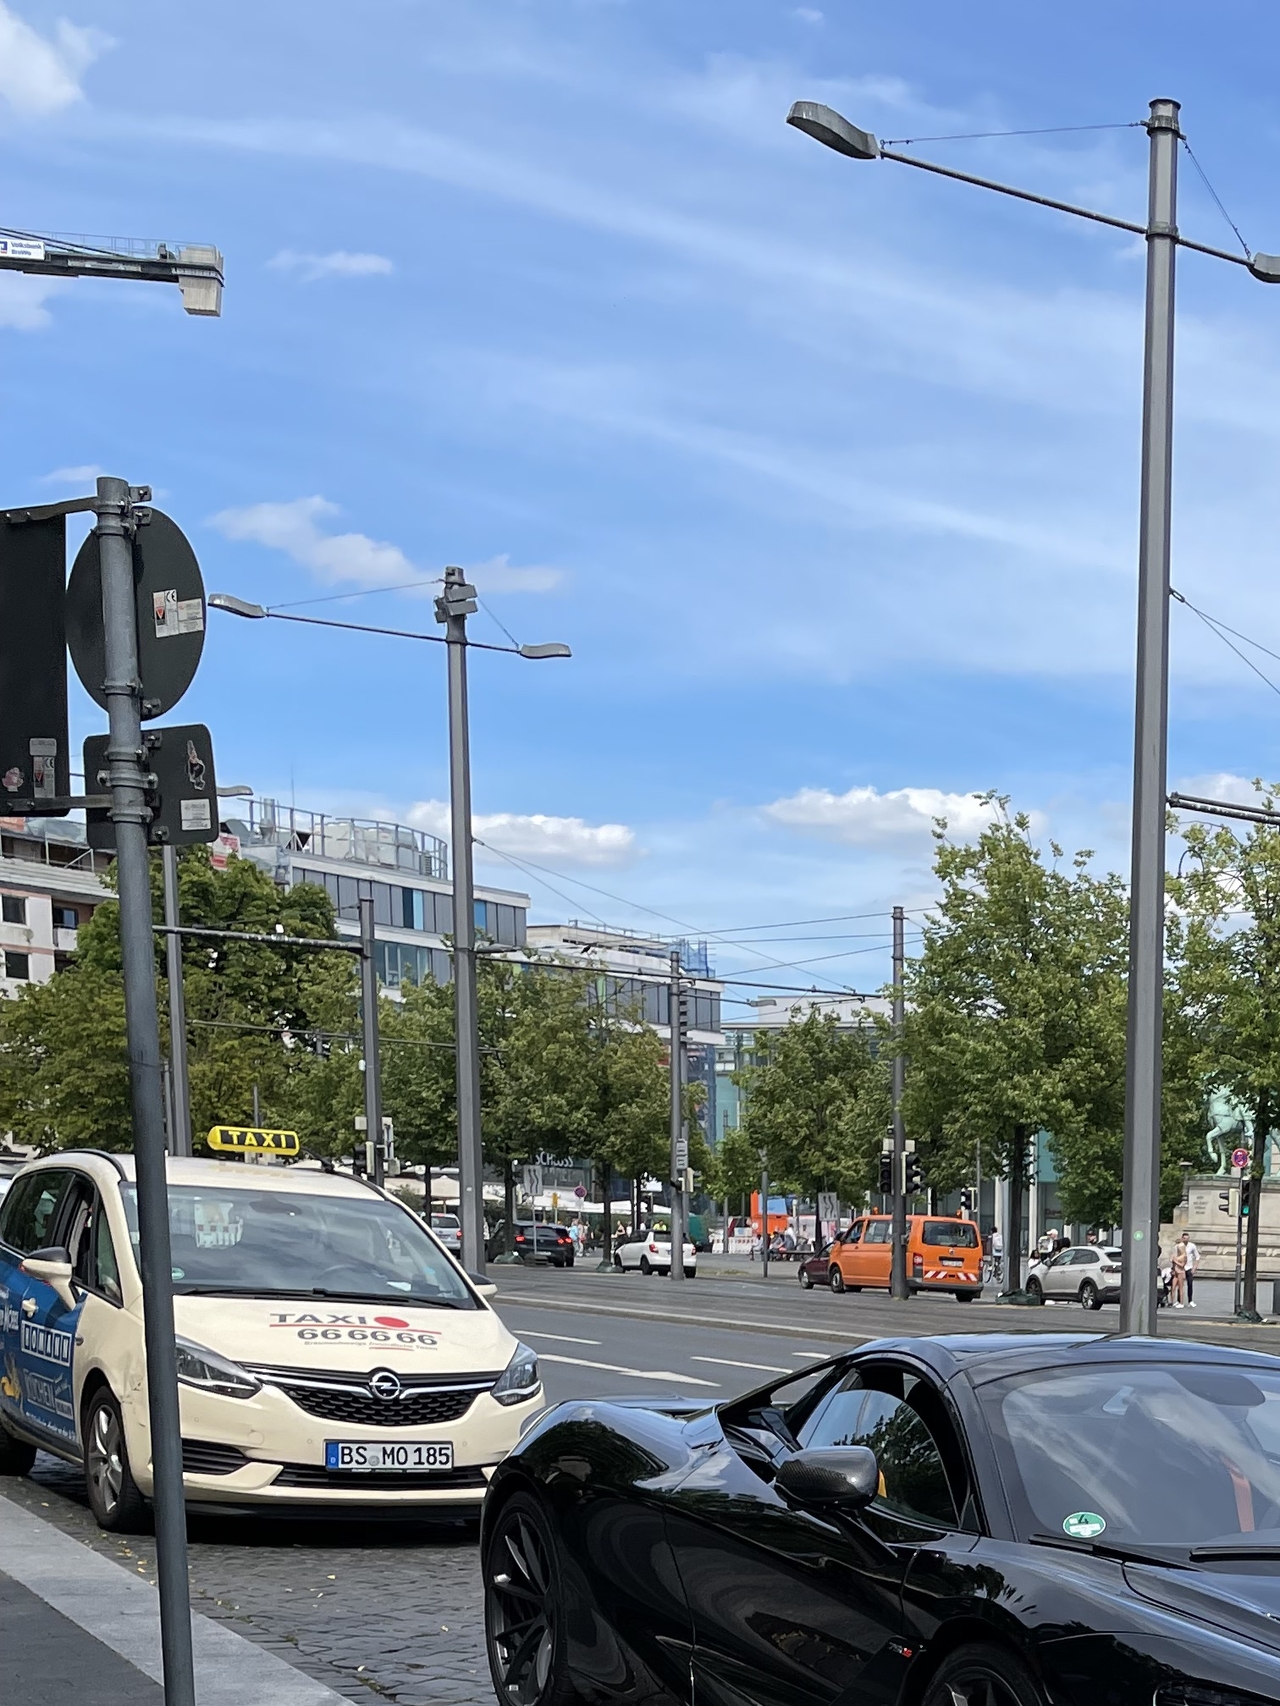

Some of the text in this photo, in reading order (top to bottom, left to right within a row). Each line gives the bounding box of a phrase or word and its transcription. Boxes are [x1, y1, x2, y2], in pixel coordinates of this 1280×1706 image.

[228, 1130, 287, 1148] TAXI
[270, 1313, 368, 1325] TAXI
[340, 1446, 368, 1465] BS
[382, 1446, 409, 1466] MO
[413, 1446, 451, 1466] 185
